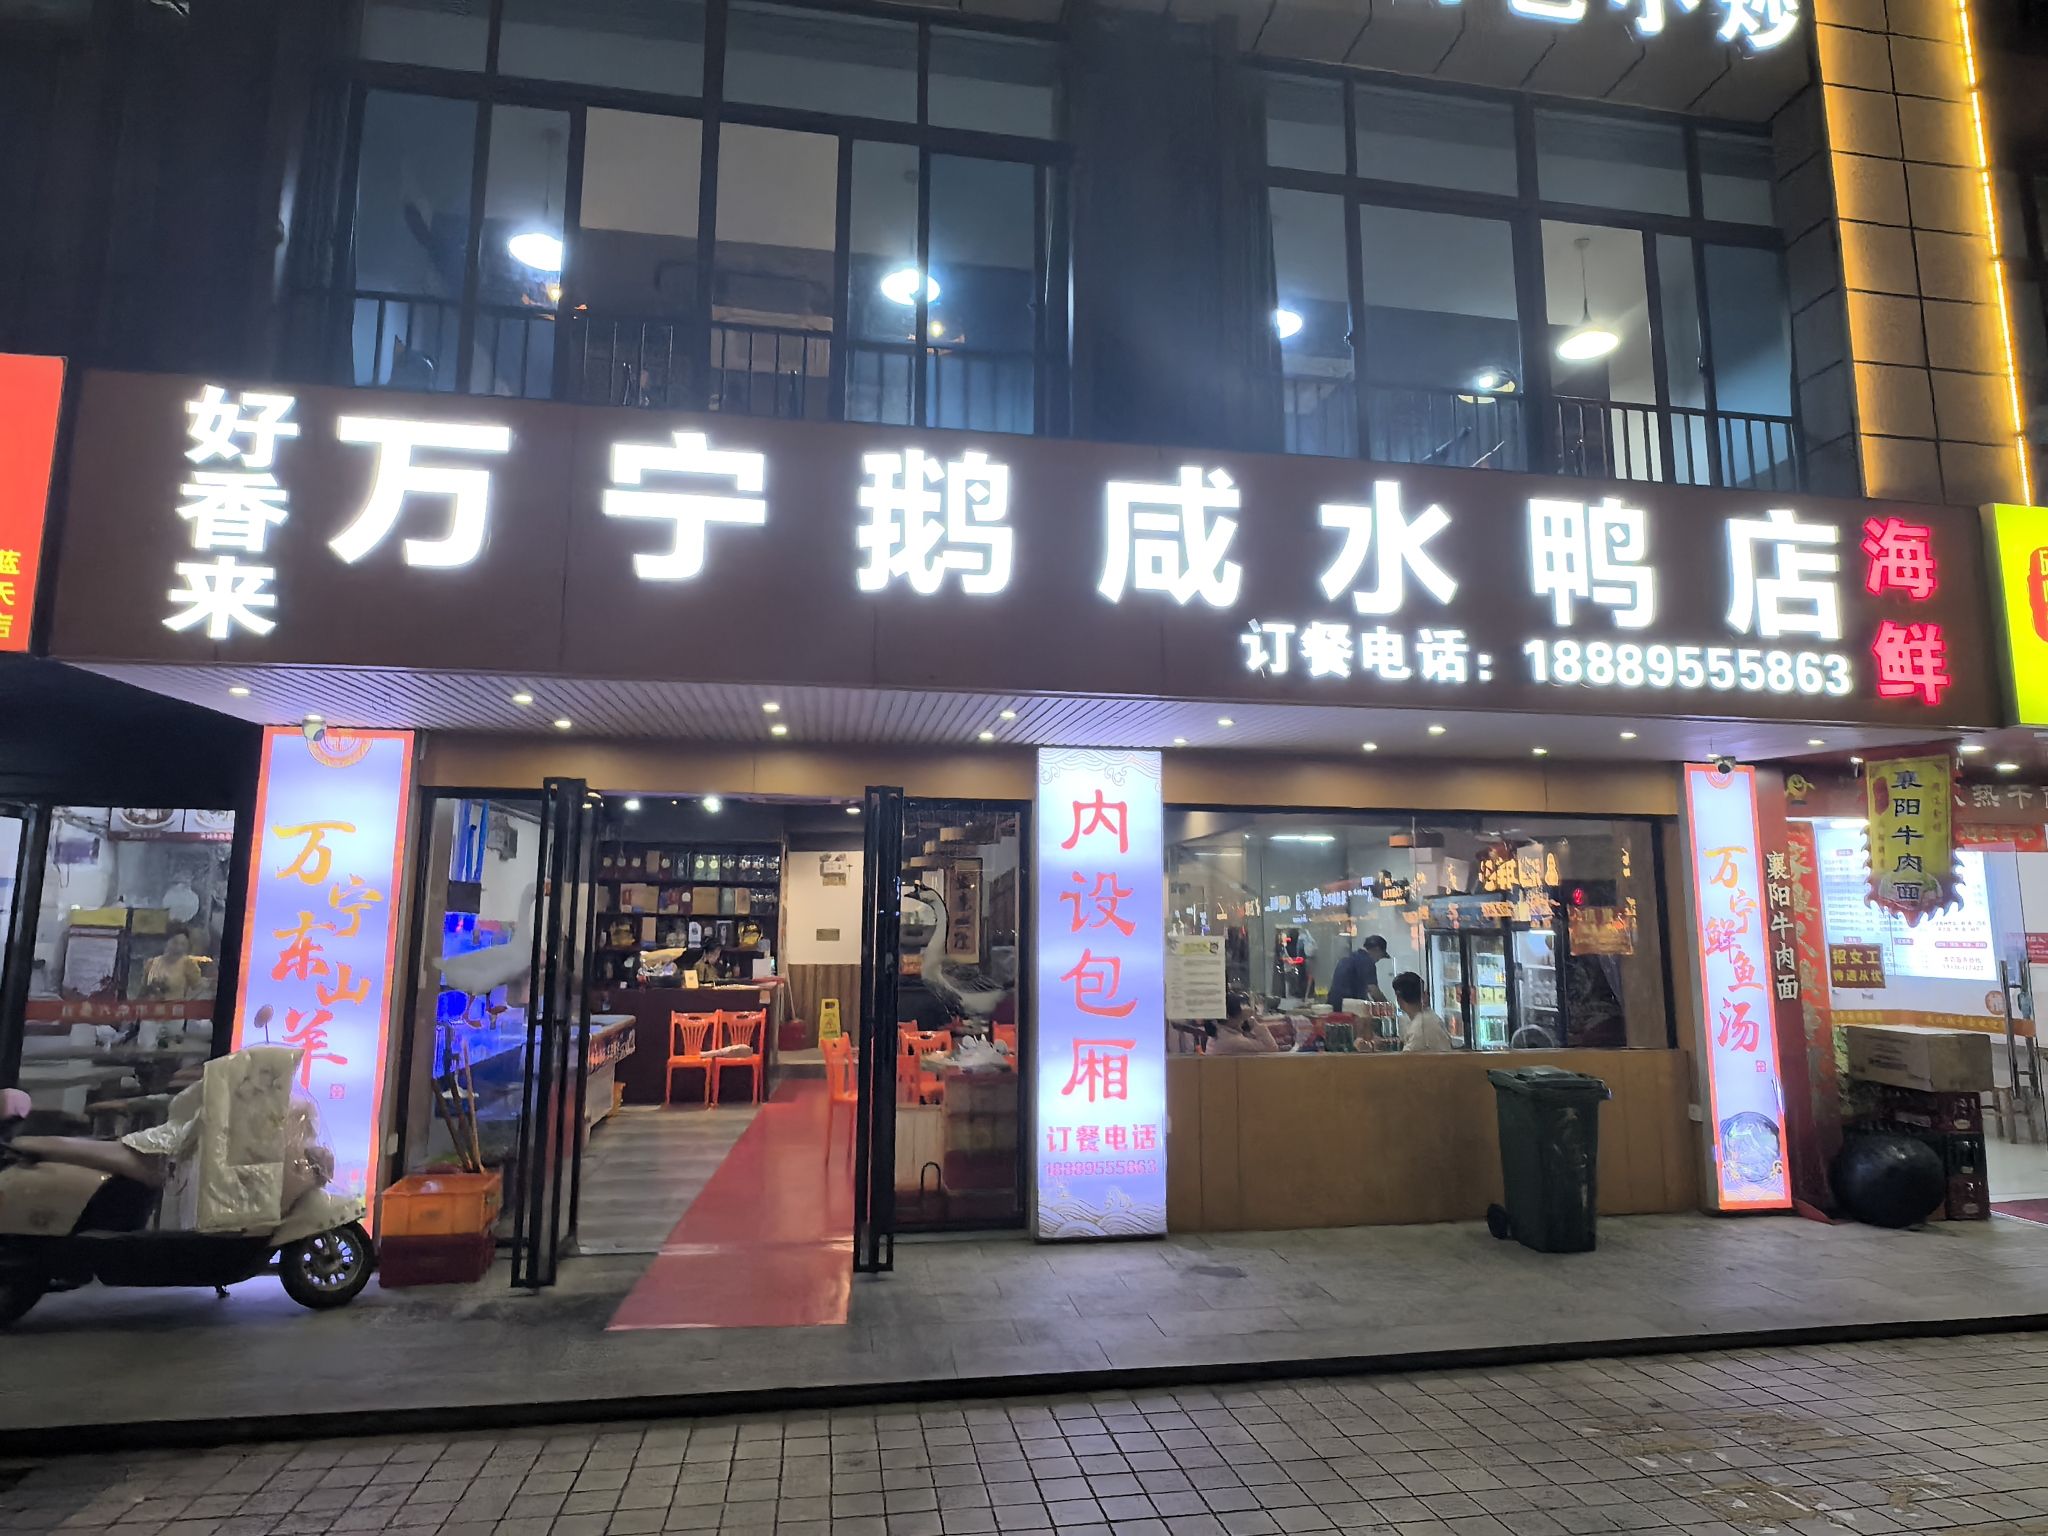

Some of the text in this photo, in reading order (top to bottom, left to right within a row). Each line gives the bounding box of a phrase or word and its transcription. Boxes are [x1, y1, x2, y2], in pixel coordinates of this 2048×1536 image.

[163, 385, 299, 639] 好香来
[328, 414, 1843, 641] 万宁鹅咸水鸭店
[1523, 639, 1853, 695] 18889555863
[1861, 517, 1950, 704] 海鲜
[1766, 851, 1799, 1000] 襄阳牛肉面
[1891, 770, 1924, 900] 襄阳牛肉面
[271, 820, 383, 1090] 万宁东山羊
[1060, 790, 1137, 1103] 内设包厢
[1702, 846, 1764, 1053] 万宁鲜鱼汤
[1045, 1159, 1157, 1176] 18889555863
[1046, 1124, 1157, 1153] 订餐电话
